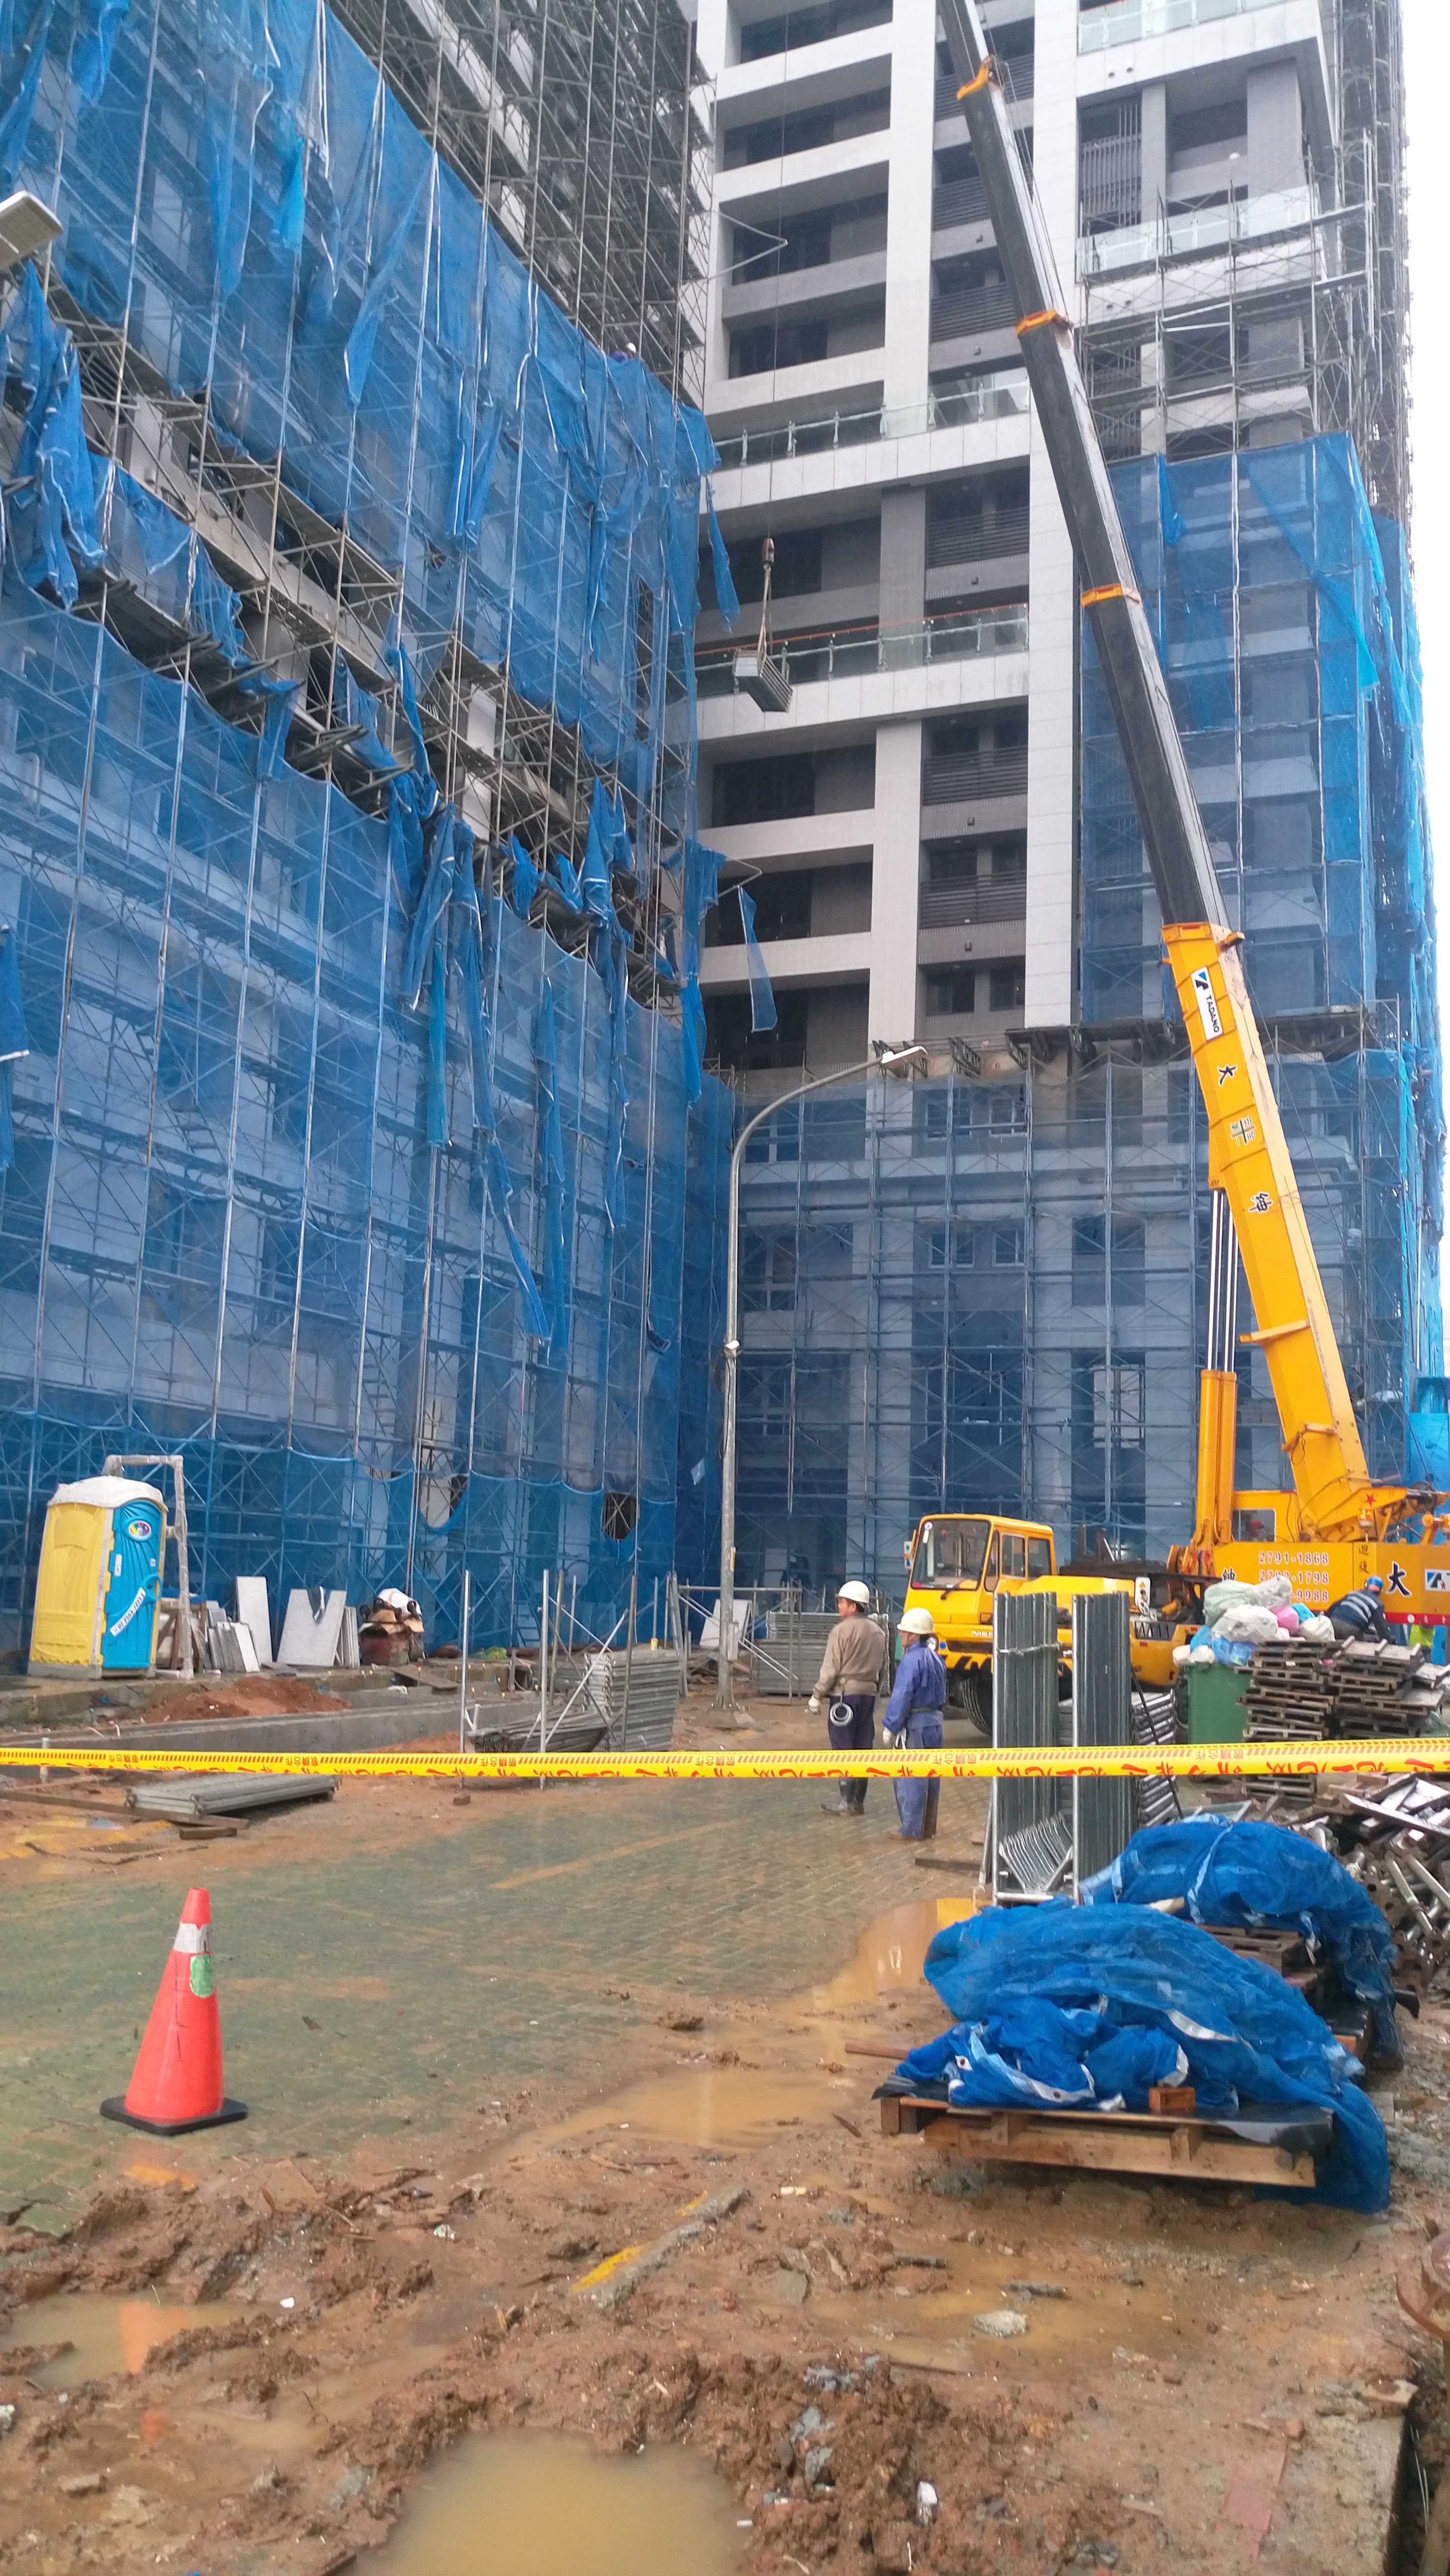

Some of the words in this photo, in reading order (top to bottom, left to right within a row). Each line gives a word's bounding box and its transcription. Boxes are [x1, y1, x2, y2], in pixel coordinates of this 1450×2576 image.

[1206, 994, 1220, 1033] TADANO
[1218, 1064, 1237, 1086] 大
[1259, 1551, 1329, 1566] 2791-1868
[1386, 1561, 1411, 1597] 大
